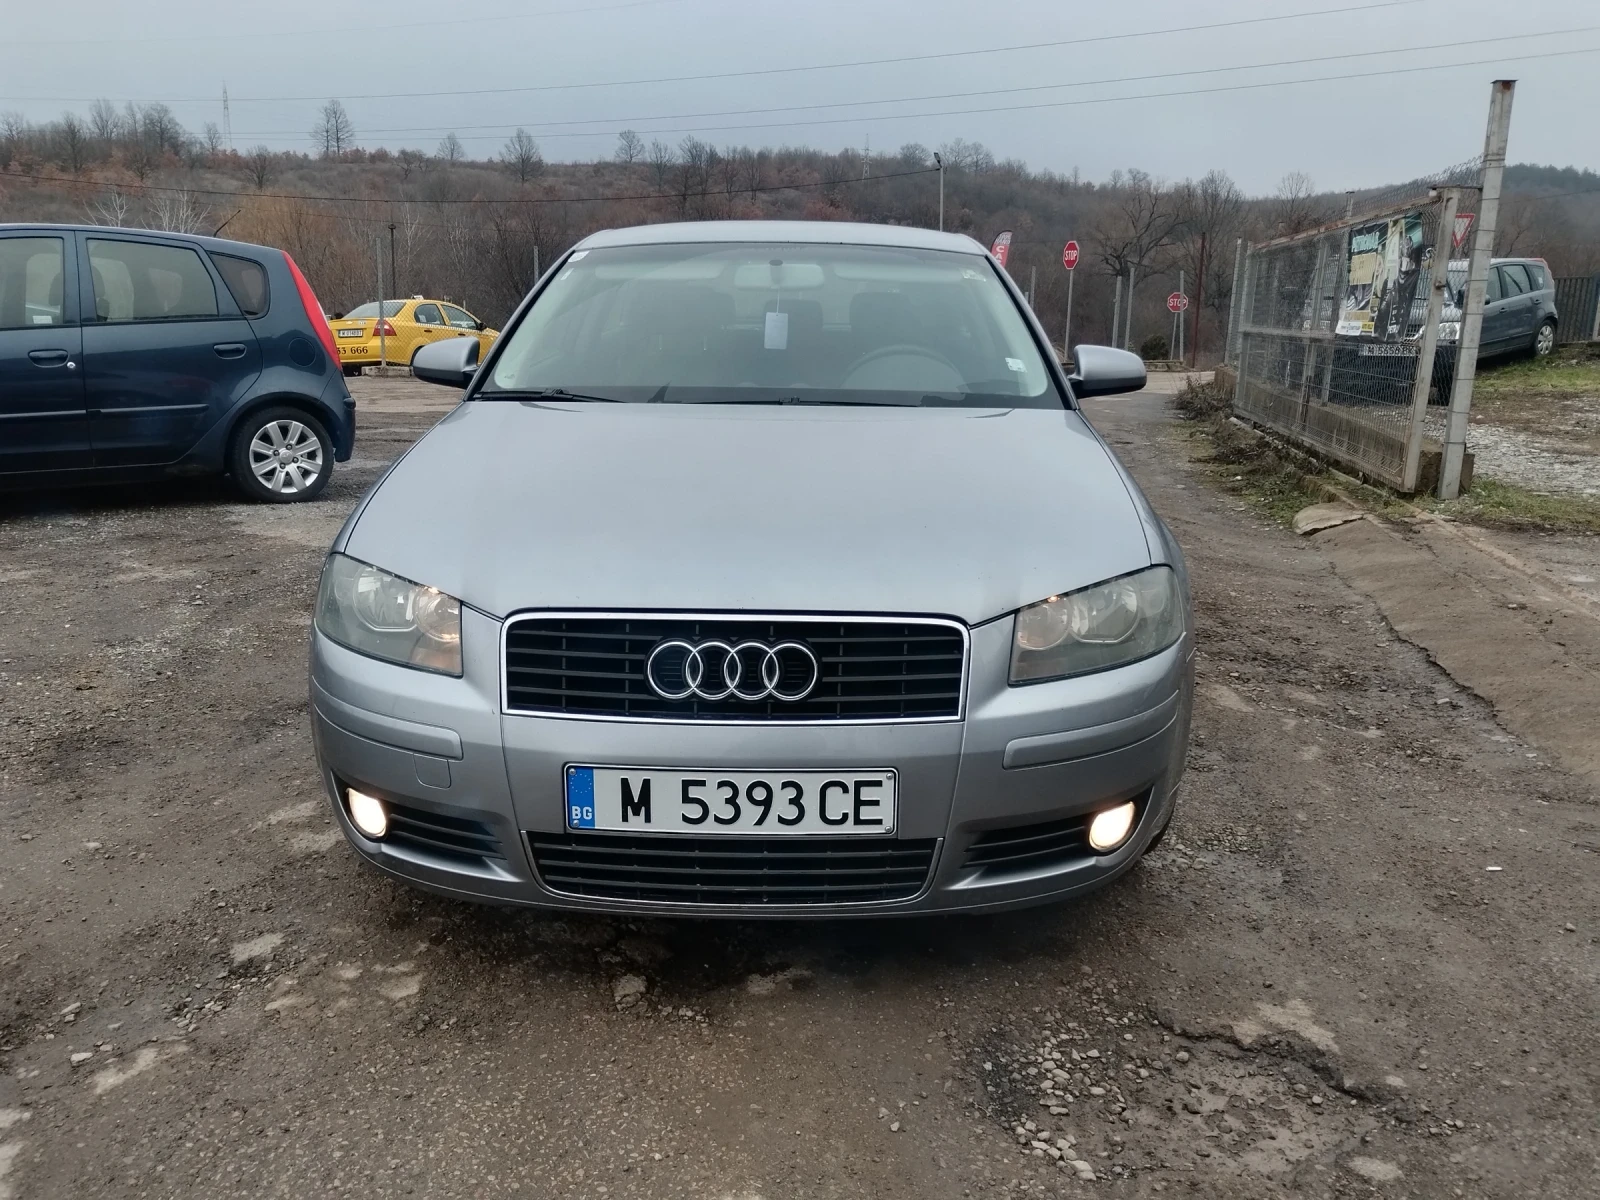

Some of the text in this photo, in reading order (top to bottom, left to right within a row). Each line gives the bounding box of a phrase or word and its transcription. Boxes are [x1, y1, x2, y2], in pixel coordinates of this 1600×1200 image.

[1064, 250, 1078, 260] STOP
[350, 346, 368, 354] 666
[620, 777, 884, 826] M 5393 CE
[571, 805, 593, 821] BG
